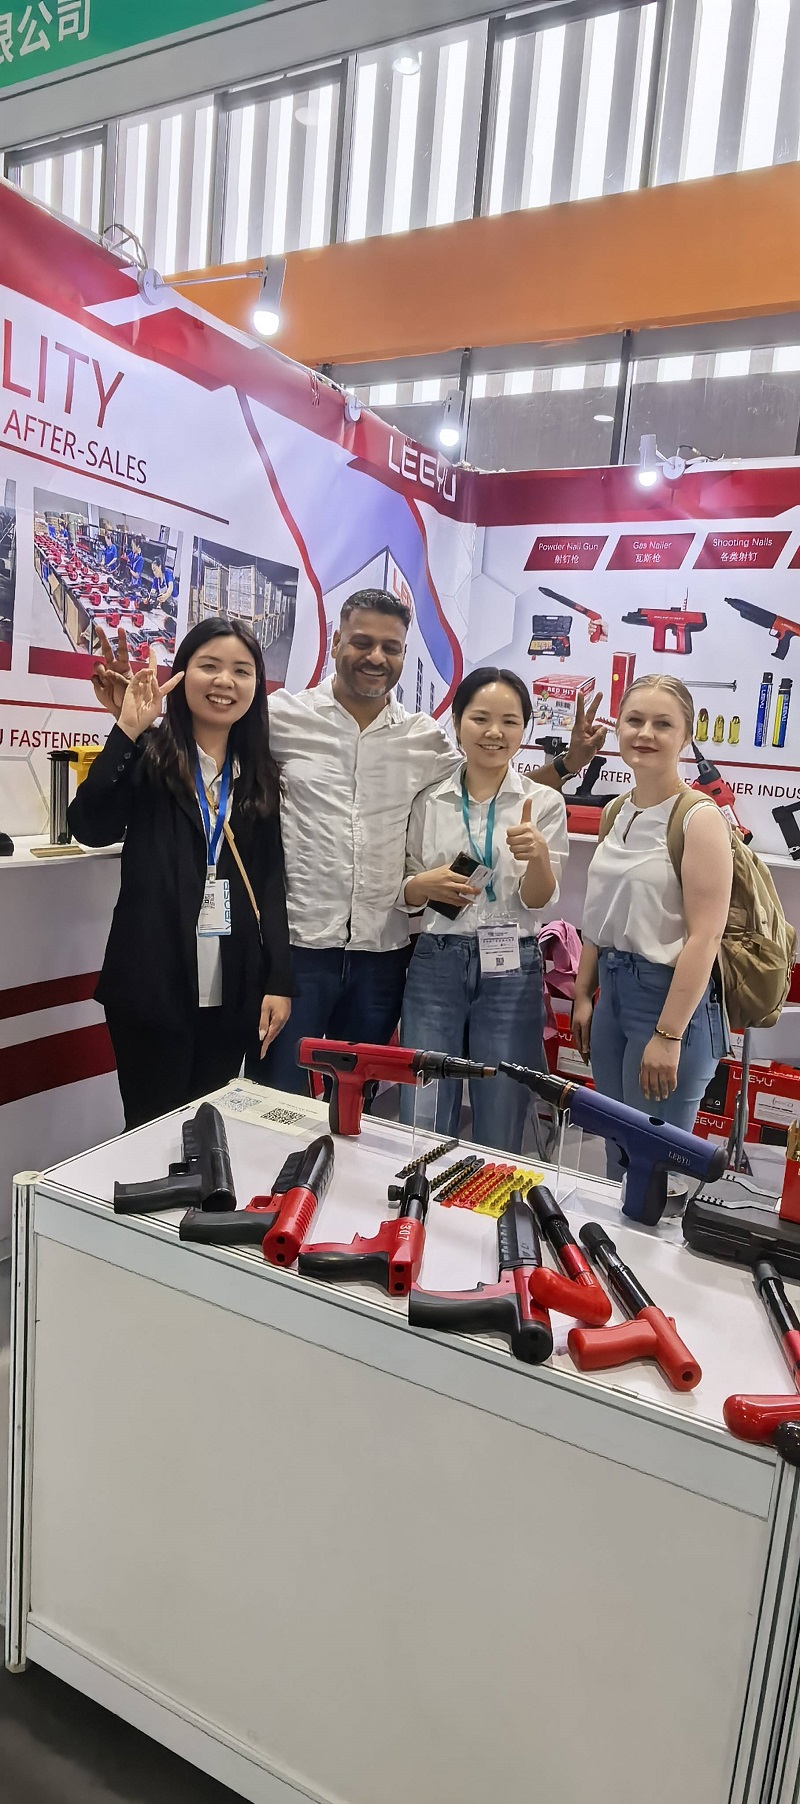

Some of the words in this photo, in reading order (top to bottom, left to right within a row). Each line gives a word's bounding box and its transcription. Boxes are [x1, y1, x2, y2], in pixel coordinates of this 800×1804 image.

[2, 318, 125, 429] LITY
[2, 408, 147, 484] AFTER-SALES
[388, 434, 457, 503] LEEYU
[538, 542, 566, 551] Powder
[566, 542, 581, 551] Nail
[582, 542, 599, 551] Gun
[632, 541, 648, 550] Gas
[649, 541, 672, 550] Nailer
[712, 538, 750, 548] Shooting
[751, 537, 773, 547] Nails
[9, 729, 100, 749] FASTENERS
[397, 1222, 412, 1241] 307
